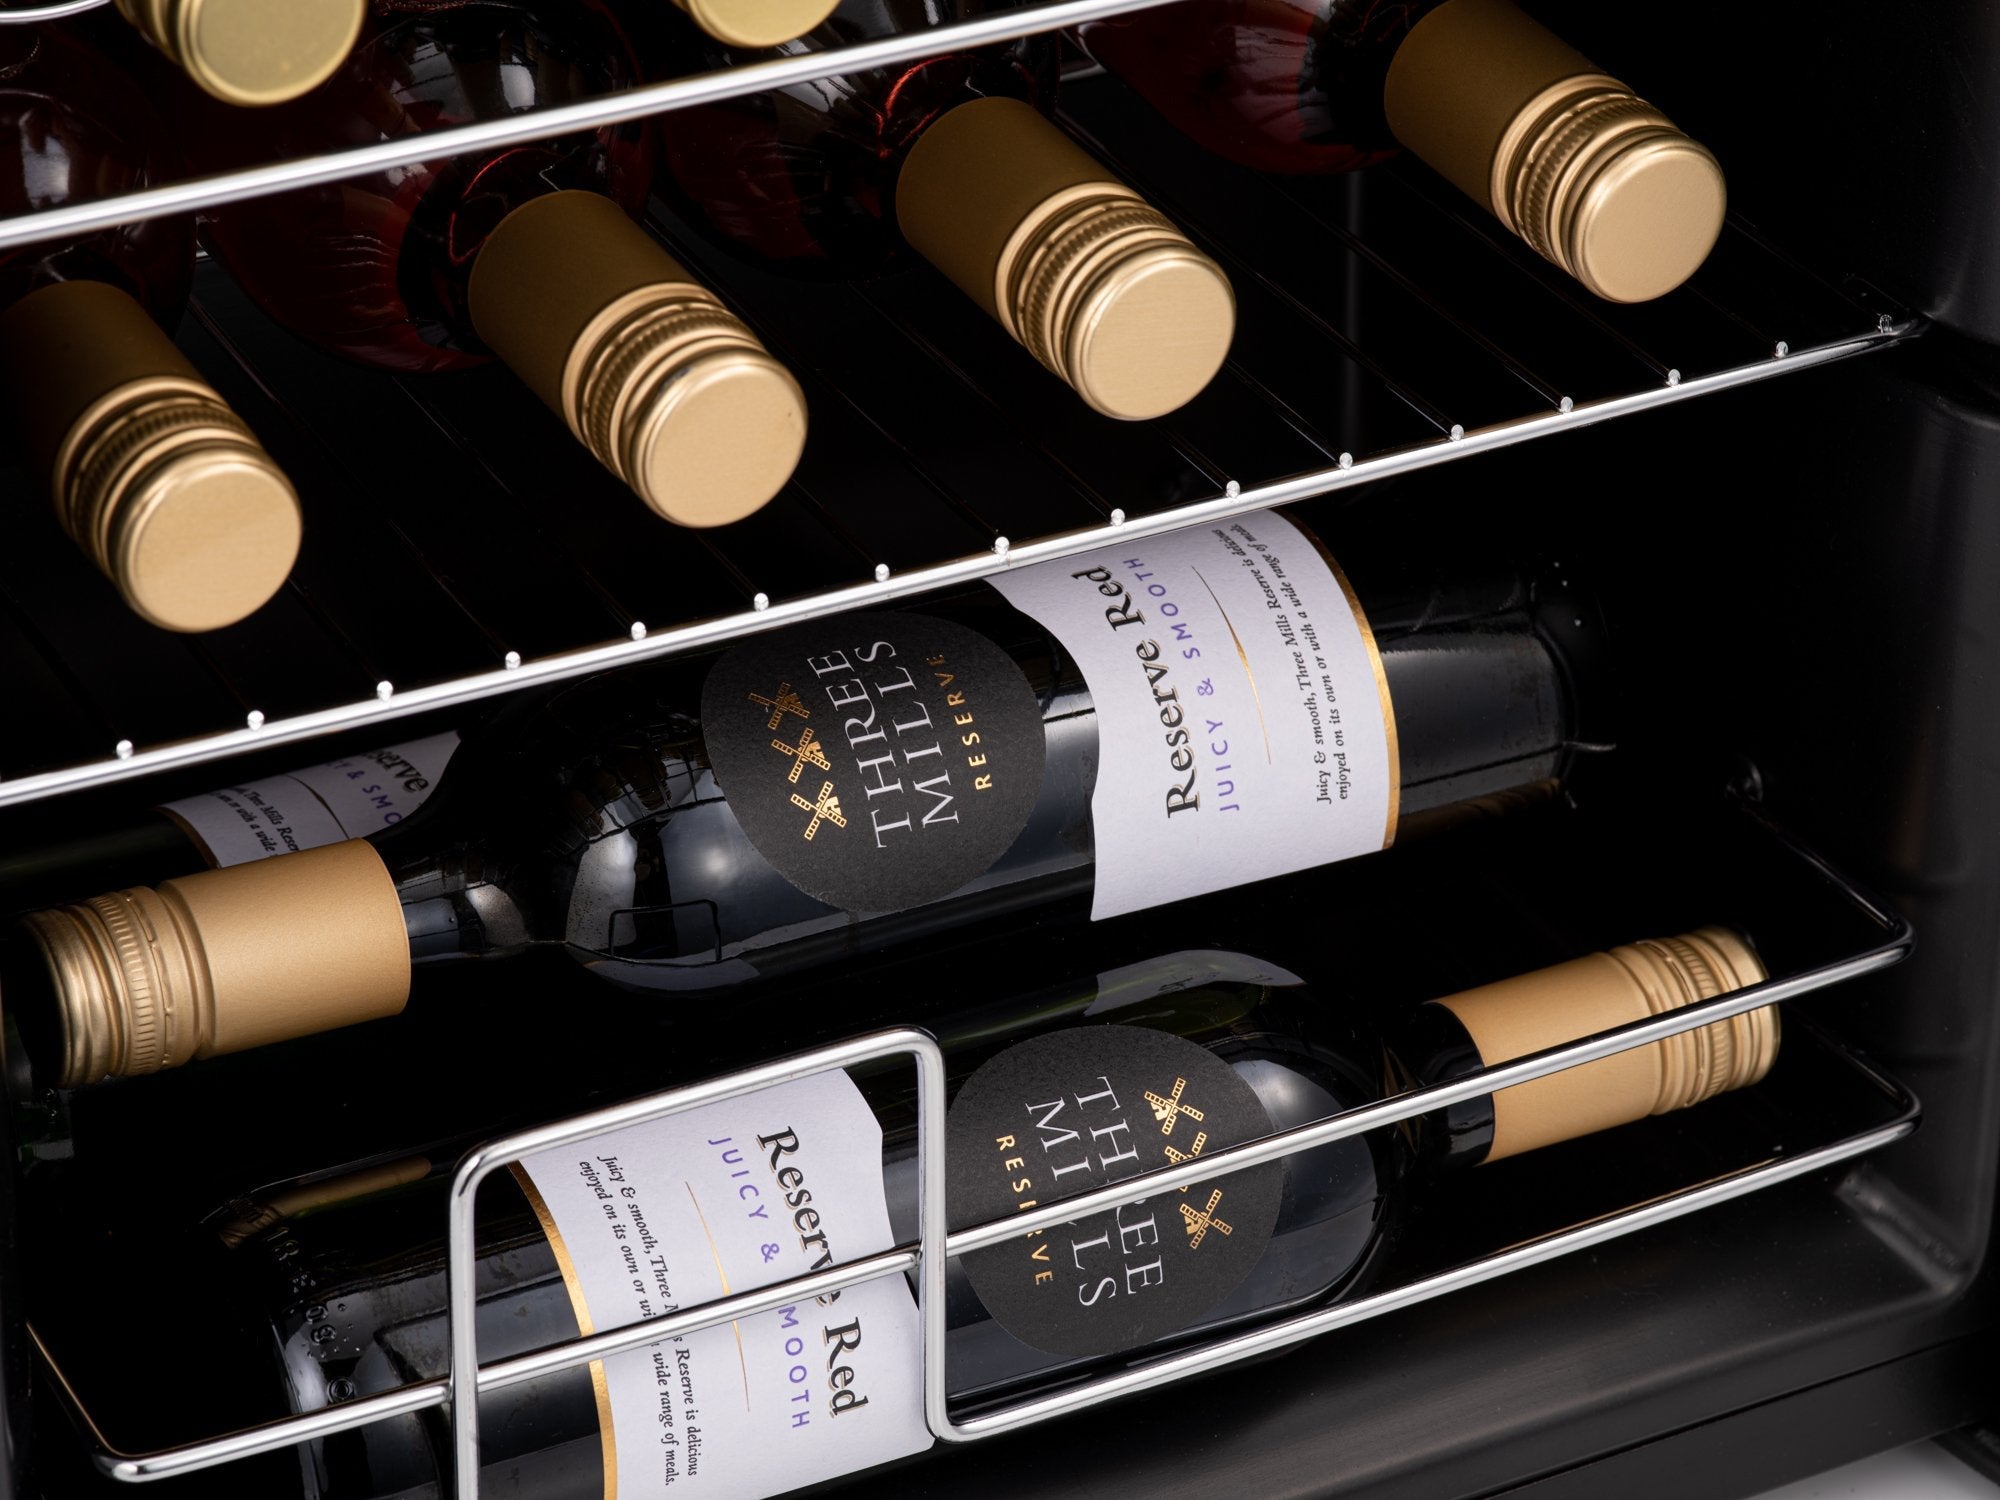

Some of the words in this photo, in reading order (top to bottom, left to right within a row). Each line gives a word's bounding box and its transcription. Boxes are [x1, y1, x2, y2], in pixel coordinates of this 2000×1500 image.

[1211, 529, 1247, 555] delicious
[1242, 559, 1255, 567] is
[1261, 554, 1287, 578] range
[1071, 565, 1146, 631] Red
[1250, 569, 1282, 610] Reserve
[1280, 582, 1303, 607] wide
[1122, 558, 1201, 660] SMOOTH
[1297, 611, 1308, 619] a
[1275, 614, 1299, 646] Mills
[1301, 623, 1321, 651] with
[1292, 651, 1312, 691] Three
[1315, 656, 1327, 669] or
[1197, 677, 1214, 696] &
[1321, 674, 1337, 703] own
[926, 654, 992, 791] RESERVE
[1136, 638, 1200, 819] Reserve
[1304, 692, 1324, 745] smooth,
[1328, 708, 1341, 724] its
[807, 650, 912, 848] THREE
[854, 641, 959, 828] MILLS
[1334, 730, 1344, 747] on
[1205, 719, 1240, 812] JUICY
[1313, 751, 1326, 764] &
[1316, 770, 1332, 805] Juicy
[1333, 752, 1351, 800] enjoyed
[255, 831, 277, 852] wide
[276, 827, 300, 851] Reser
[579, 1160, 614, 1200] enjoyed
[597, 1155, 626, 1182] Juicy
[620, 1187, 636, 1199] &
[1025, 1096, 1117, 1306] MILS
[1074, 1076, 1163, 1295] THEE
[603, 1203, 618, 1220] on
[612, 1224, 627, 1240] its
[627, 1203, 659, 1255] smooth,
[620, 1244, 639, 1274] own
[633, 1279, 647, 1294] or
[650, 1255, 672, 1298] Three
[707, 1137, 769, 1219] JUICY
[760, 1243, 780, 1263] &
[777, 1304, 810, 1429] MOOTH
[639, 1299, 657, 1317] wi
[652, 1351, 671, 1386] wide
[675, 1348, 694, 1405] Reserve
[822, 1316, 869, 1418] Red
[658, 1390, 674, 1428] range
[685, 1409, 699, 1421] is
[660, 1432, 680, 1446] of
[686, 1426, 702, 1476] delicious
[665, 1449, 680, 1487] meals.
